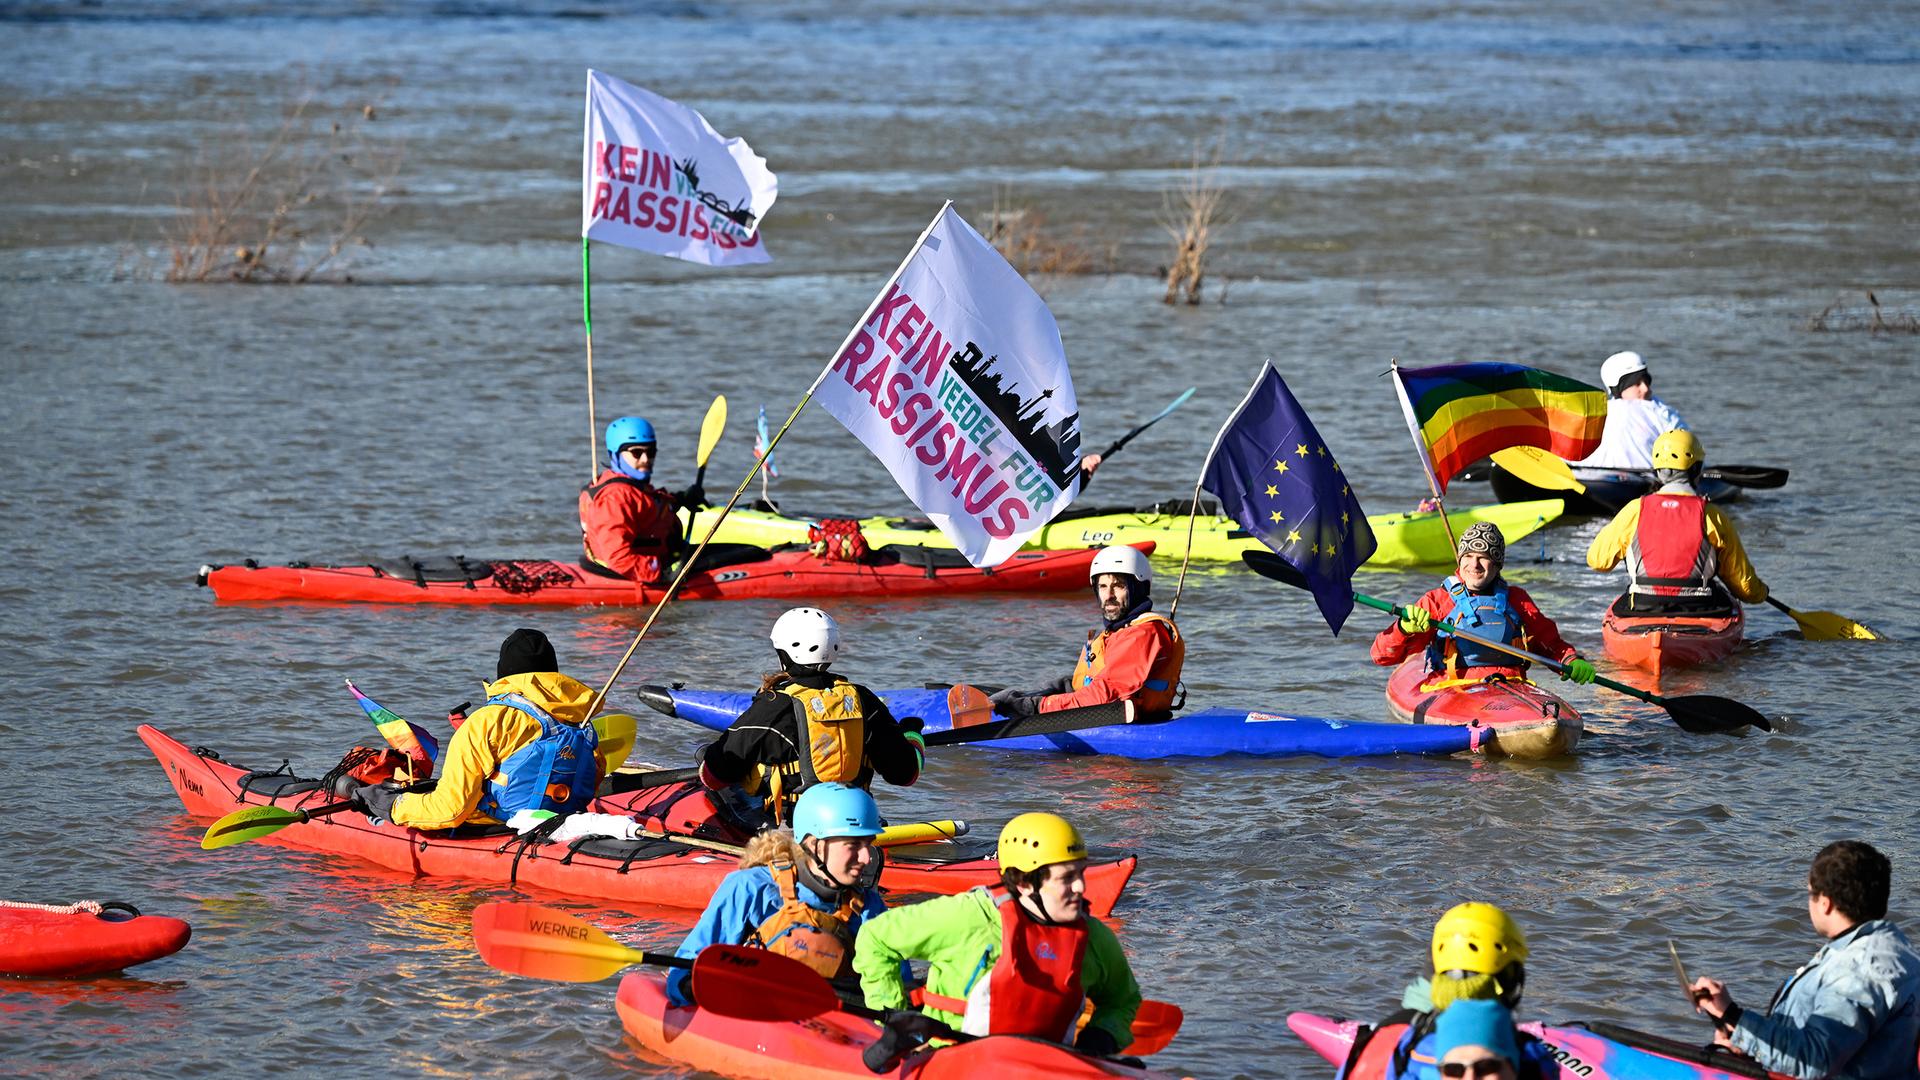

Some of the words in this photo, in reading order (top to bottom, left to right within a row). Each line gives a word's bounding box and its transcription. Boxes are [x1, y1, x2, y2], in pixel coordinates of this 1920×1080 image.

[596, 141, 671, 191] KEIN
[867, 283, 952, 387] KEIN
[833, 333, 1030, 541] RASSISMUS
[937, 369, 1003, 456] VEEDEL
[999, 451, 1054, 513] FÜR
[1082, 530, 1113, 541] Leo
[179, 767, 204, 797] Nemo
[529, 920, 589, 940] WERNER
